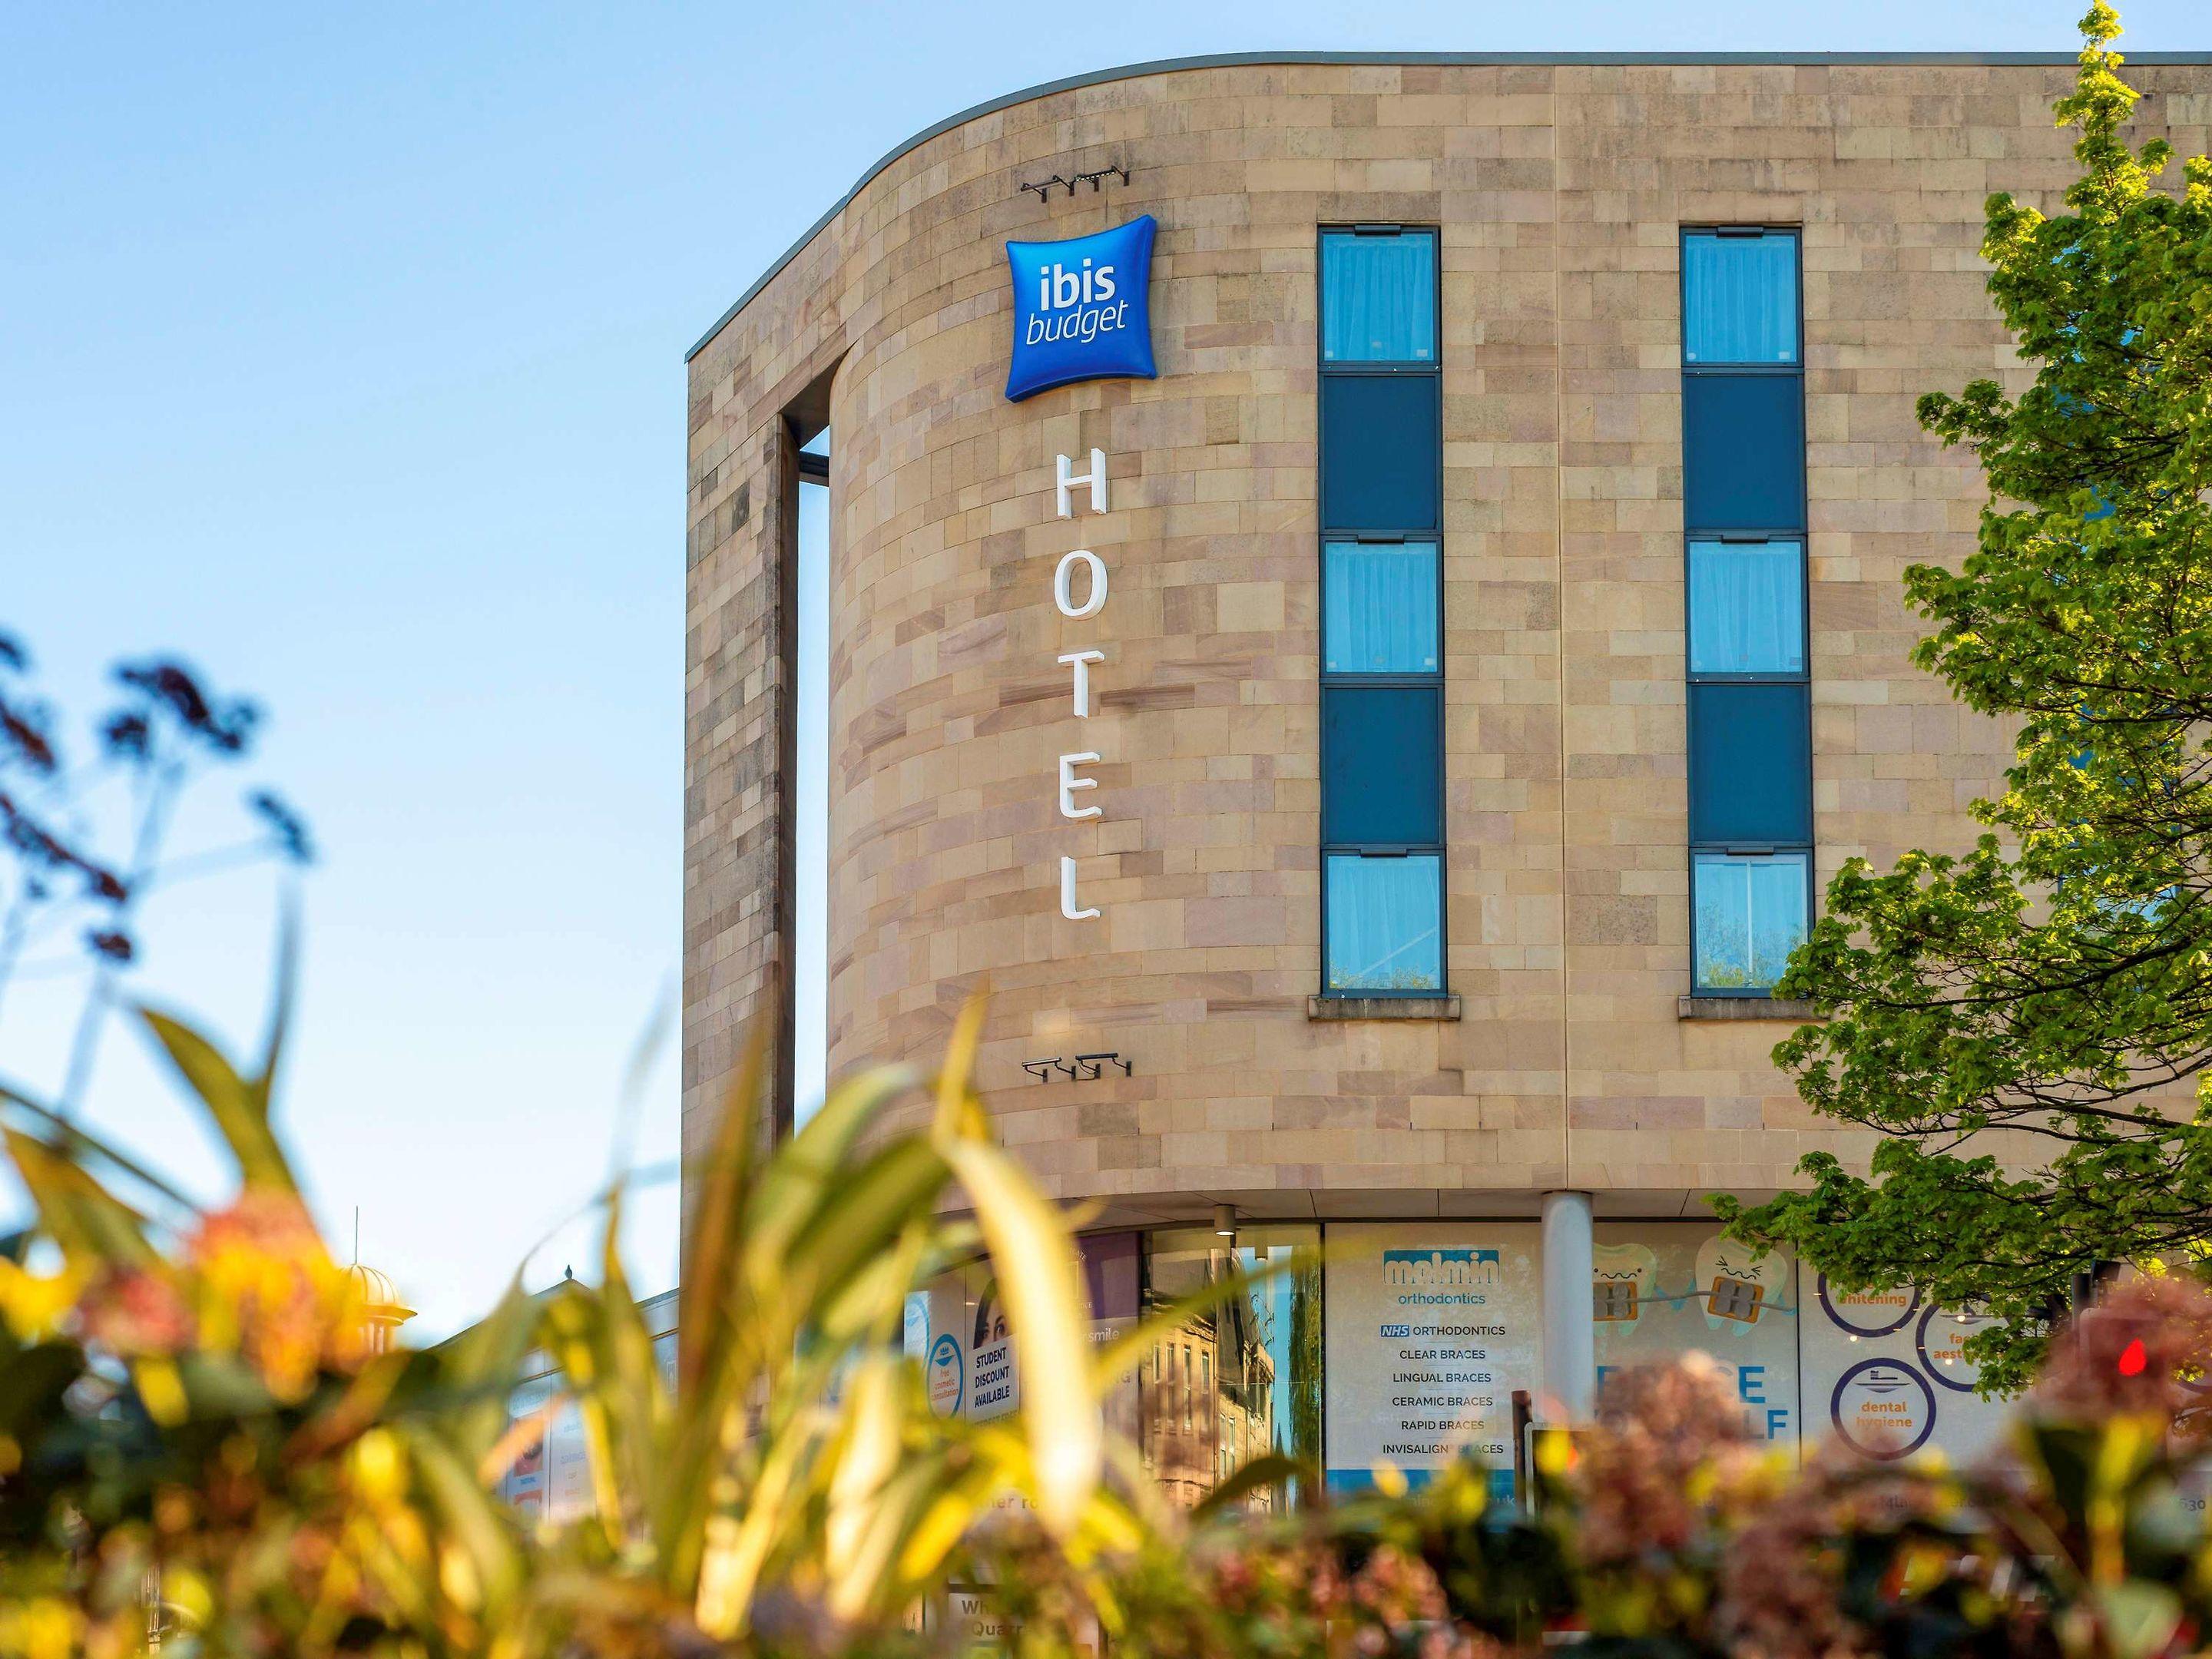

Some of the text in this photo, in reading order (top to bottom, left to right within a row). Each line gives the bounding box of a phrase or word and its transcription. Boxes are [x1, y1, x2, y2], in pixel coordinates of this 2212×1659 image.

[1039, 257, 1116, 311] ibis
[1026, 300, 1128, 345] budget
[1054, 447, 1109, 921] HOTEL
[1398, 1293, 1486, 1304] orthodontics
[1381, 1326, 1506, 1336] NHS ORTHODONTICS
[975, 1347, 1007, 1369] STUDENT
[1399, 1350, 1486, 1359] CLEAR BRACES
[975, 1366, 1010, 1389] DISCOUNT
[1392, 1373, 1492, 1383] LINGUAL BRACES
[974, 1386, 1010, 1409] AVAILABLE
[1392, 1397, 1493, 1406] CERAMIC BRACES
[1861, 1402, 1907, 1412] dental
[1401, 1421, 1485, 1430] RAPID BRACES
